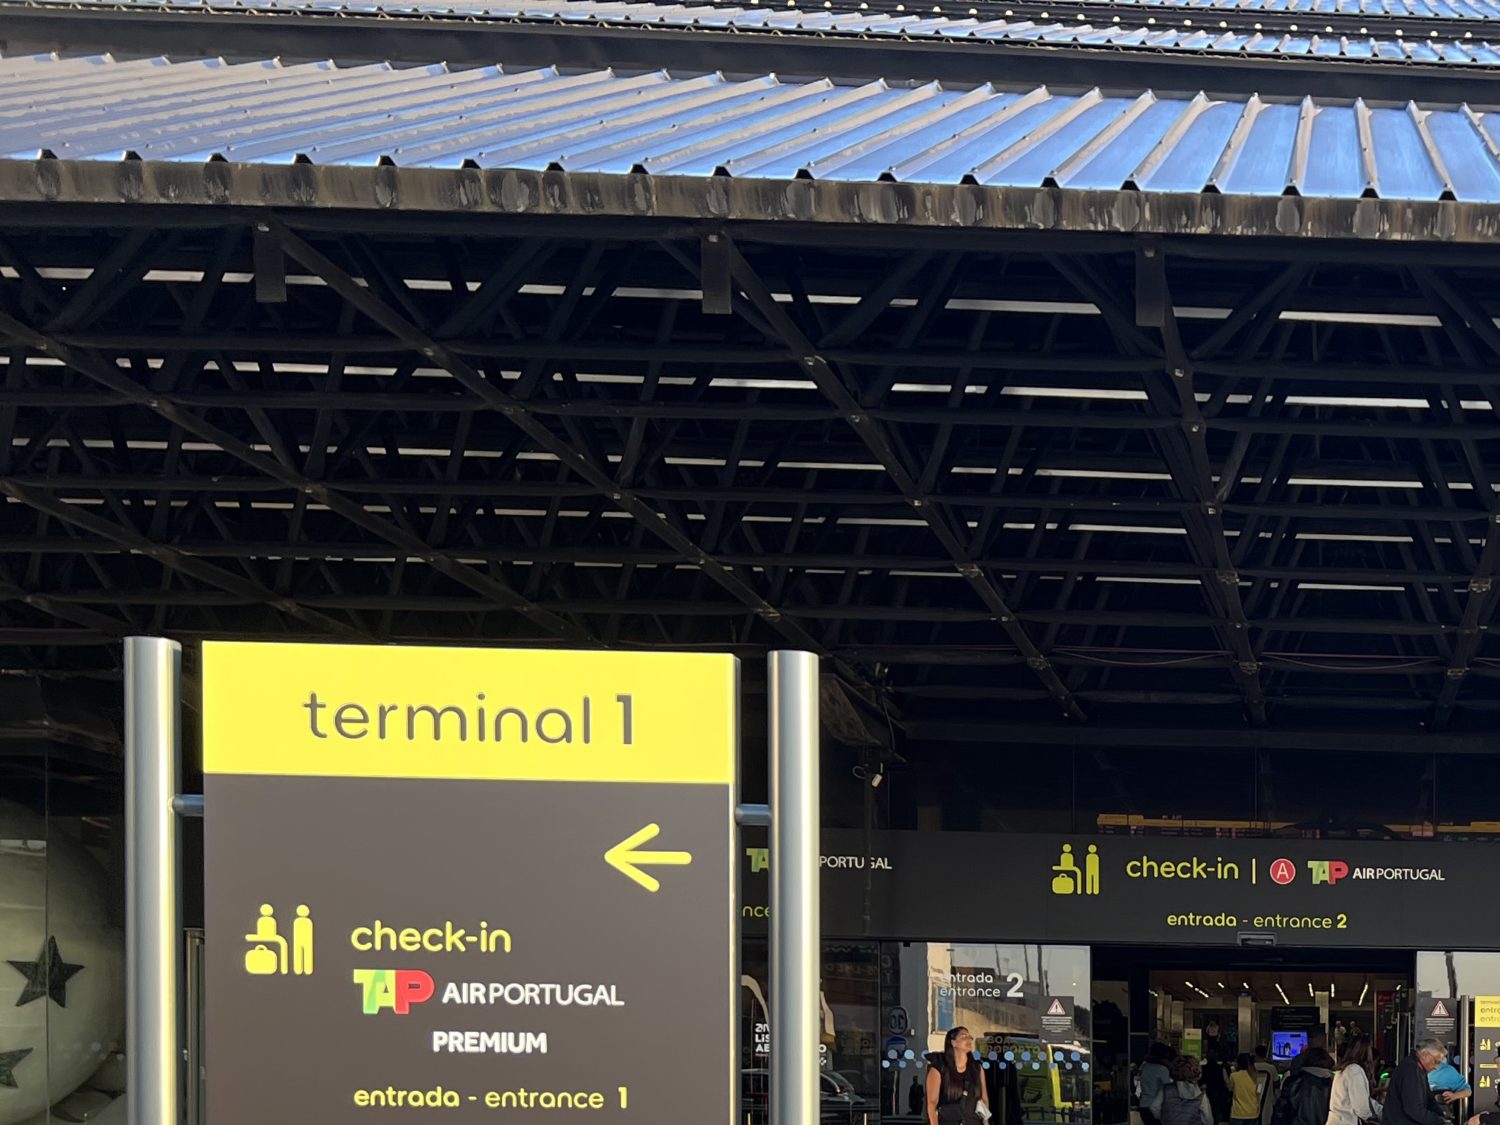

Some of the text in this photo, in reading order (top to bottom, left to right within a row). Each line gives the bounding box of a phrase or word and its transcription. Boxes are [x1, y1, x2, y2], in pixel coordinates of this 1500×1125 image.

[303, 691, 634, 746] terminal 1
[1126, 855, 1239, 880] check-in
[1307, 859, 1349, 886] TAP
[1167, 912, 1237, 928] entrada
[1253, 914, 1333, 929] entrance
[1336, 913, 1348, 929] 2
[351, 920, 512, 954] check-in
[353, 968, 435, 1015] TAP
[940, 987, 1001, 997] entrance
[1006, 972, 1024, 998] 2
[432, 1031, 548, 1054] PREMIUM
[353, 1086, 460, 1109] entrada
[485, 1087, 604, 1110] entrance
[617, 1086, 628, 1109] 1
